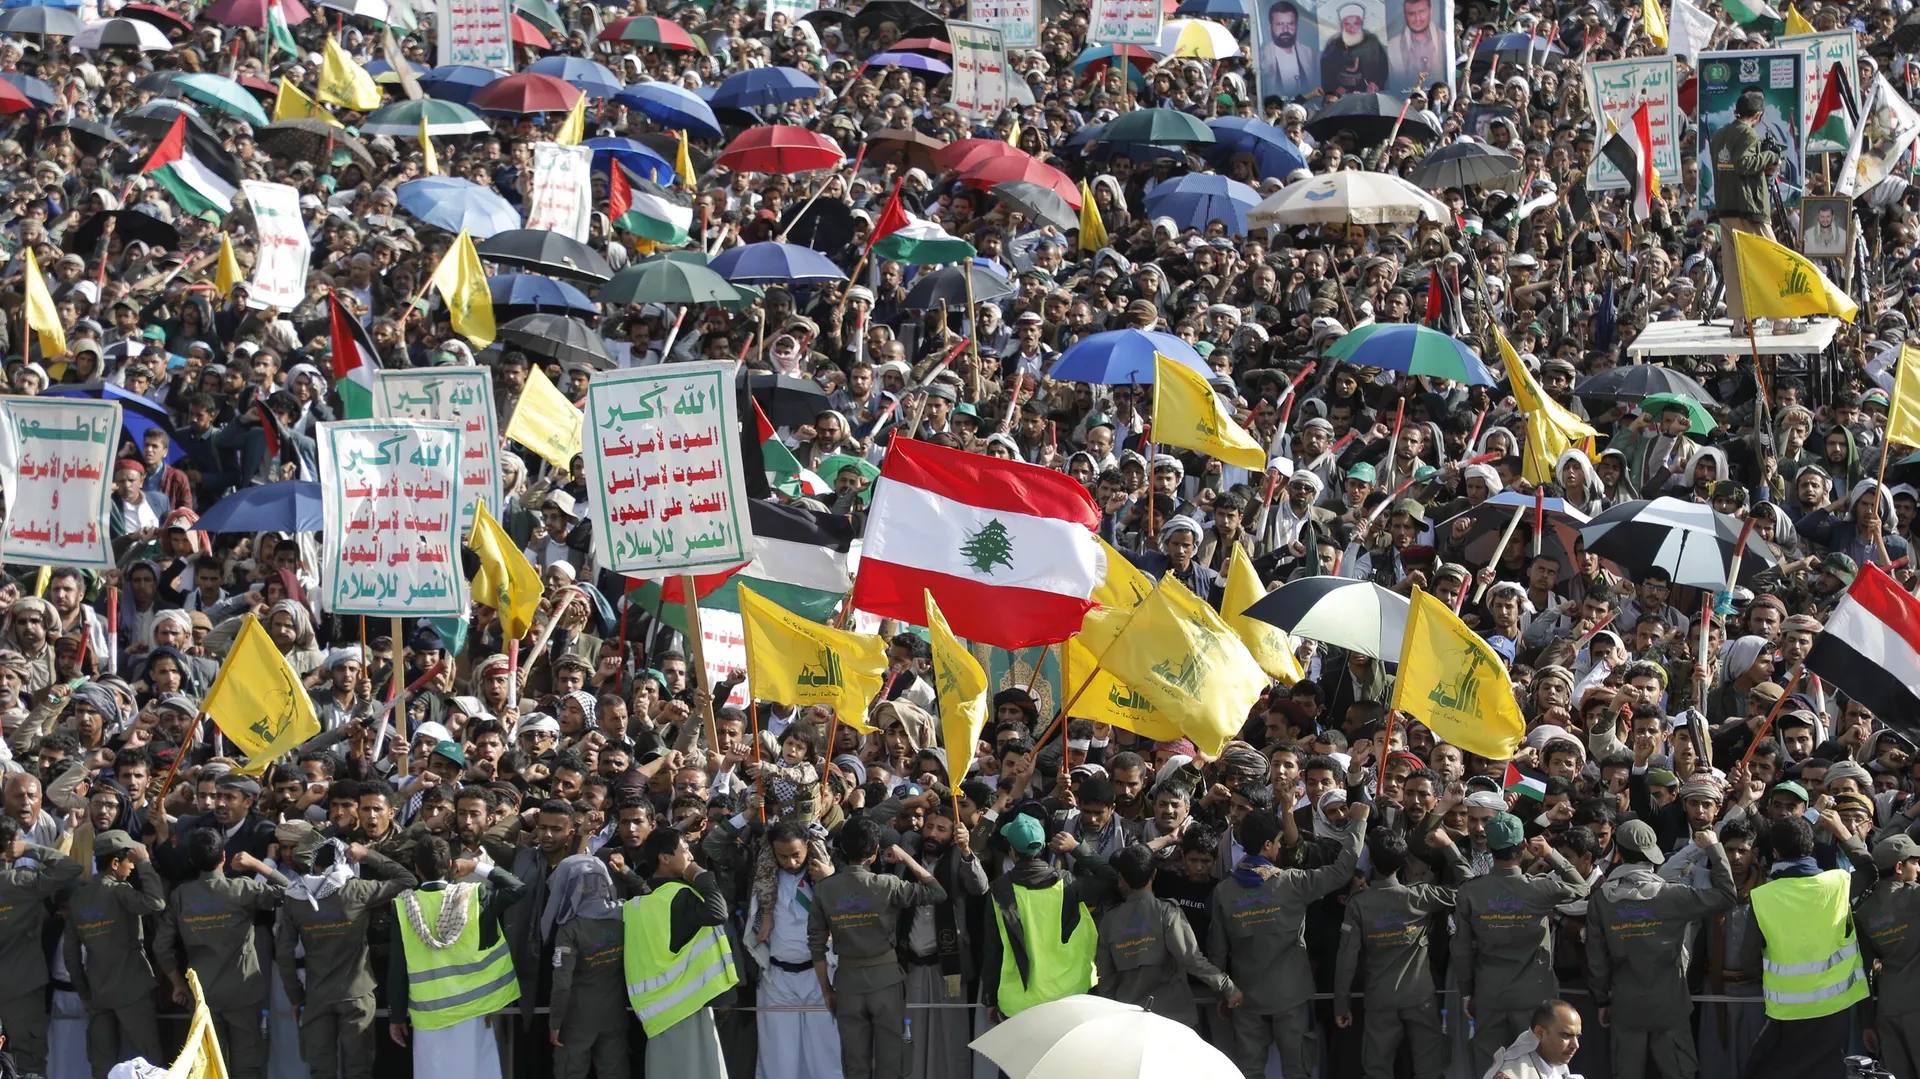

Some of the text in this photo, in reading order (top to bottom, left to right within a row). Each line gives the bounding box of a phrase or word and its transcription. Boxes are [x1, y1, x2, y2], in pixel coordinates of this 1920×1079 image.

[1600, 66, 1668, 96] الله أكبر
[392, 377, 482, 412] الله أكبر
[600, 382, 716, 432] الله أكبر
[14, 412, 108, 444] قاطعوا
[603, 425, 718, 459] الموت لأمريكا
[341, 431, 451, 475] الله أكبر
[344, 472, 450, 503] الموت لأمريكا
[608, 459, 723, 494] الموت لإسرائيل
[51, 489, 59, 510] و
[611, 491, 727, 526] اللعنة على اليهود
[344, 508, 448, 536] الموت لإسرائيل
[342, 541, 448, 567] اللعنة على اليهود
[616, 520, 733, 565] النصر للإسلام
[339, 568, 453, 607] النصر للإسلام
